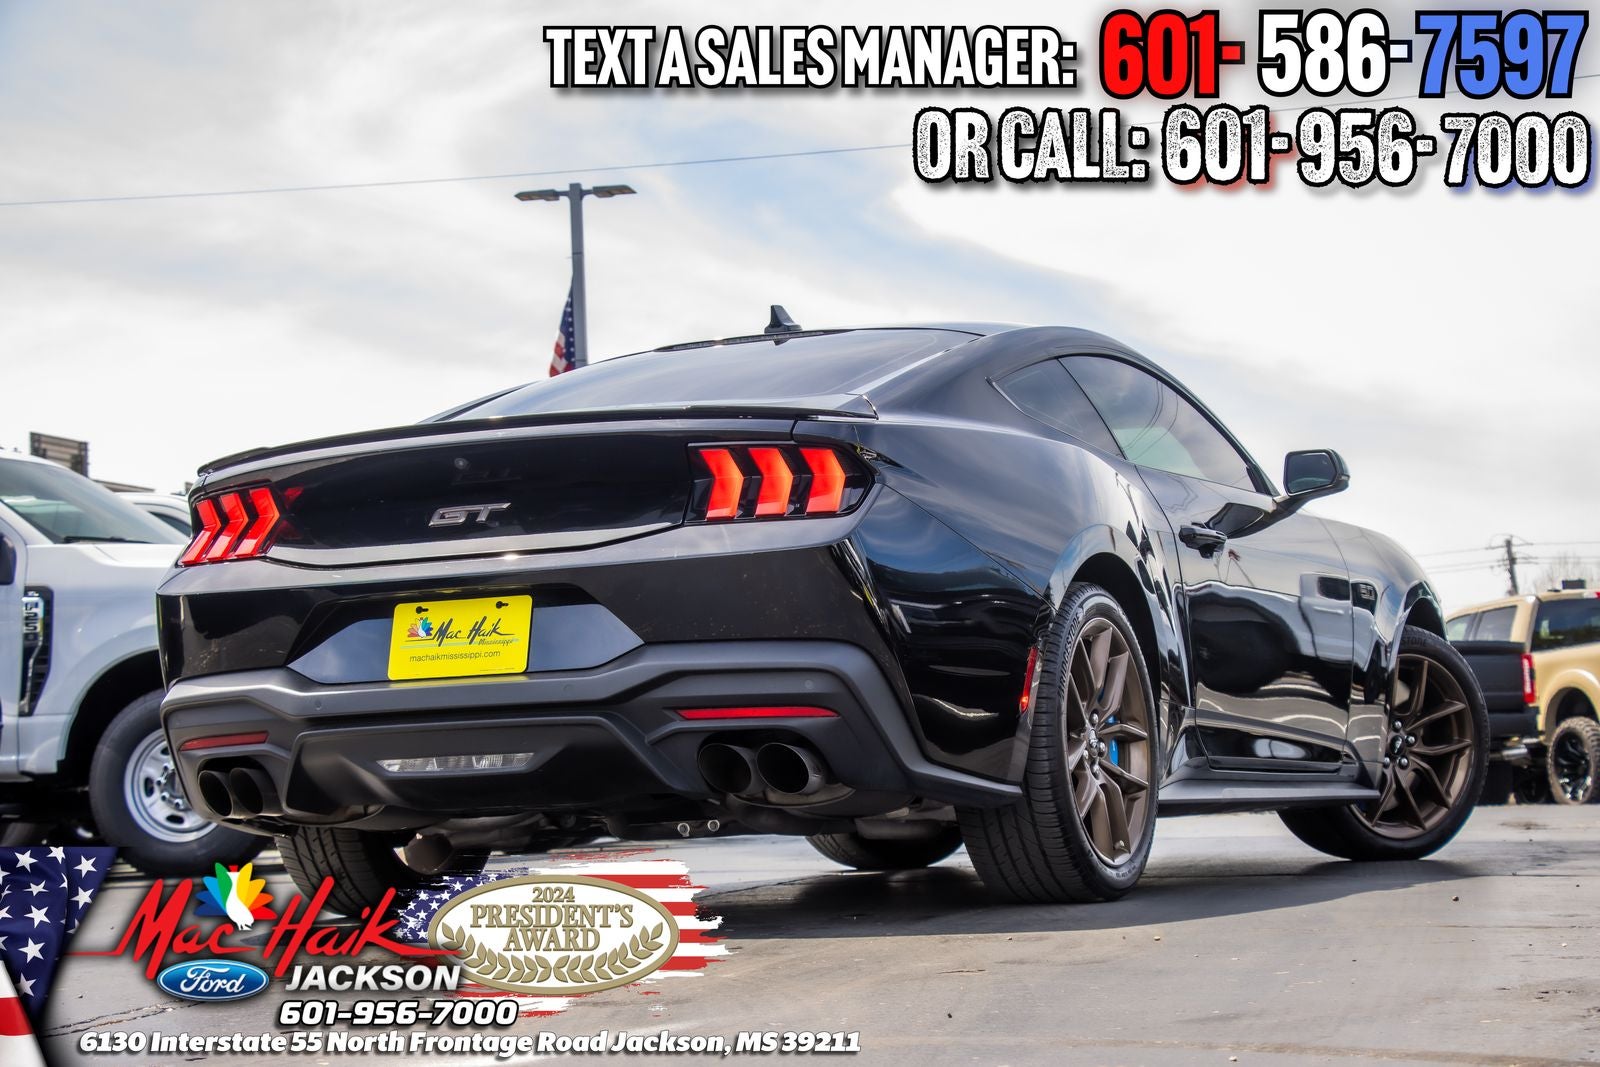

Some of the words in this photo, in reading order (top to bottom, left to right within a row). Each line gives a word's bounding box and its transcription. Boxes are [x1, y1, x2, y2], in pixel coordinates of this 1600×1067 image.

[428, 502, 511, 528] GT
[466, 615, 515, 645] Haik
[409, 649, 501, 663] machaikmississippi.com
